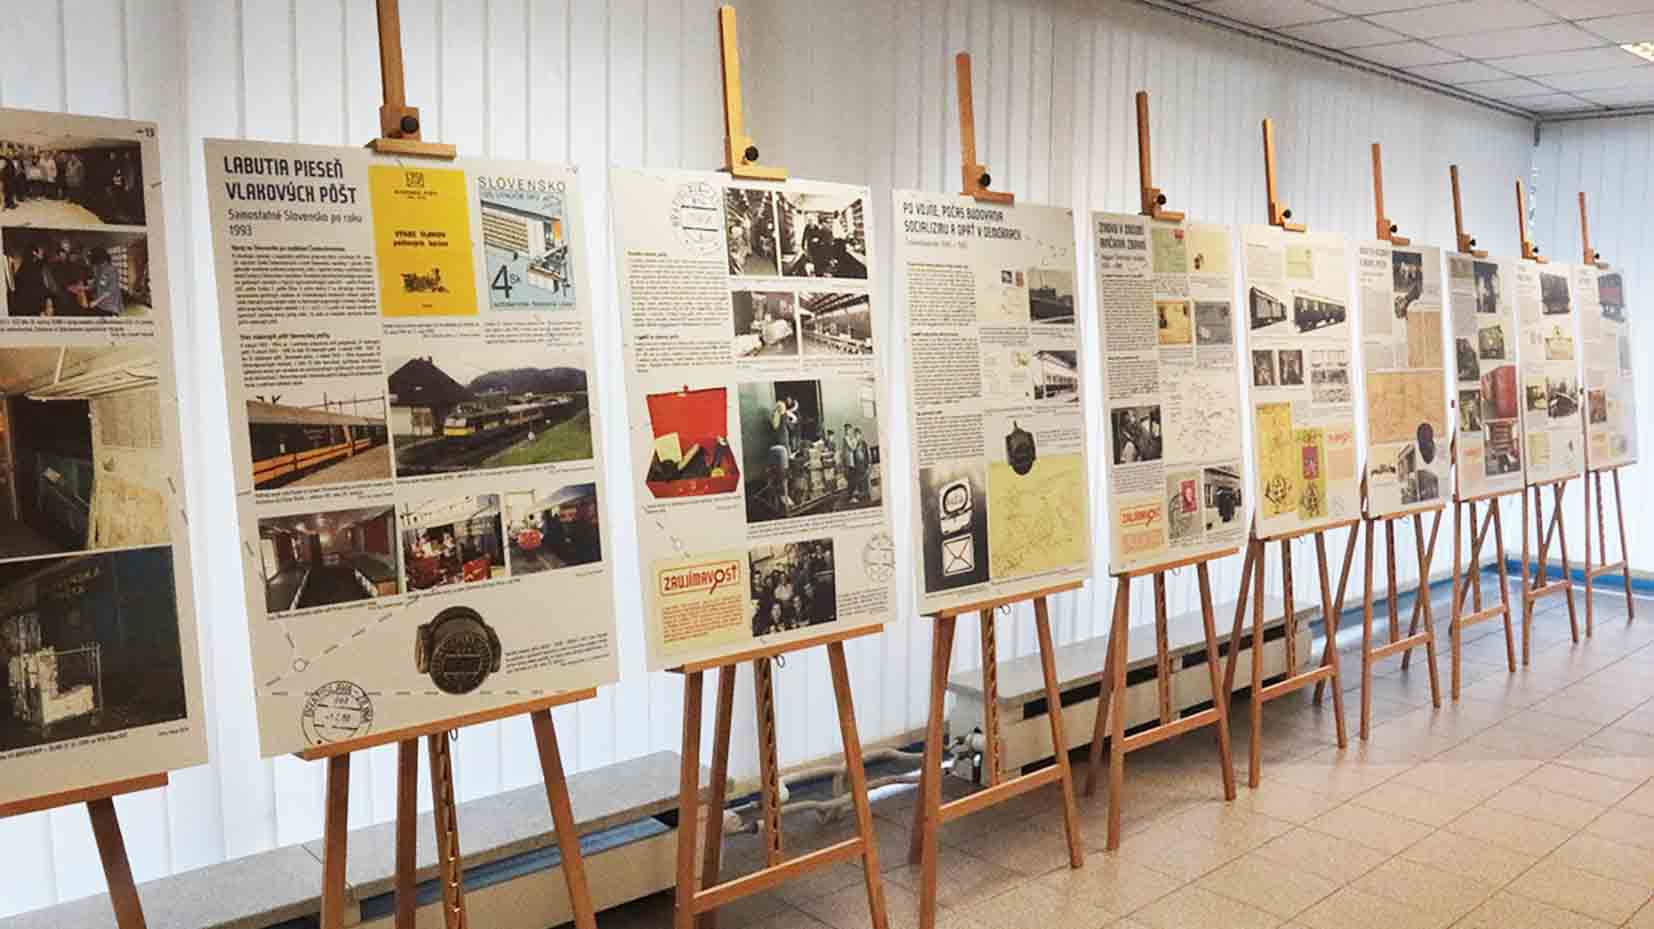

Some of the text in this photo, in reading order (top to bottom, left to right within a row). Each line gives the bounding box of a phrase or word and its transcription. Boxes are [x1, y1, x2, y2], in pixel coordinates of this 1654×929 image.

[224, 156, 343, 178] LABUTIA PIESEŇ
[478, 175, 566, 192] SLOVENSKO
[226, 182, 356, 204] VLAKOVÝCH PÔŠT
[228, 208, 362, 224] Samostatné Slovensko po roku
[903, 202, 913, 214] PO
[229, 225, 252, 236] 1993
[491, 265, 513, 298] 4
